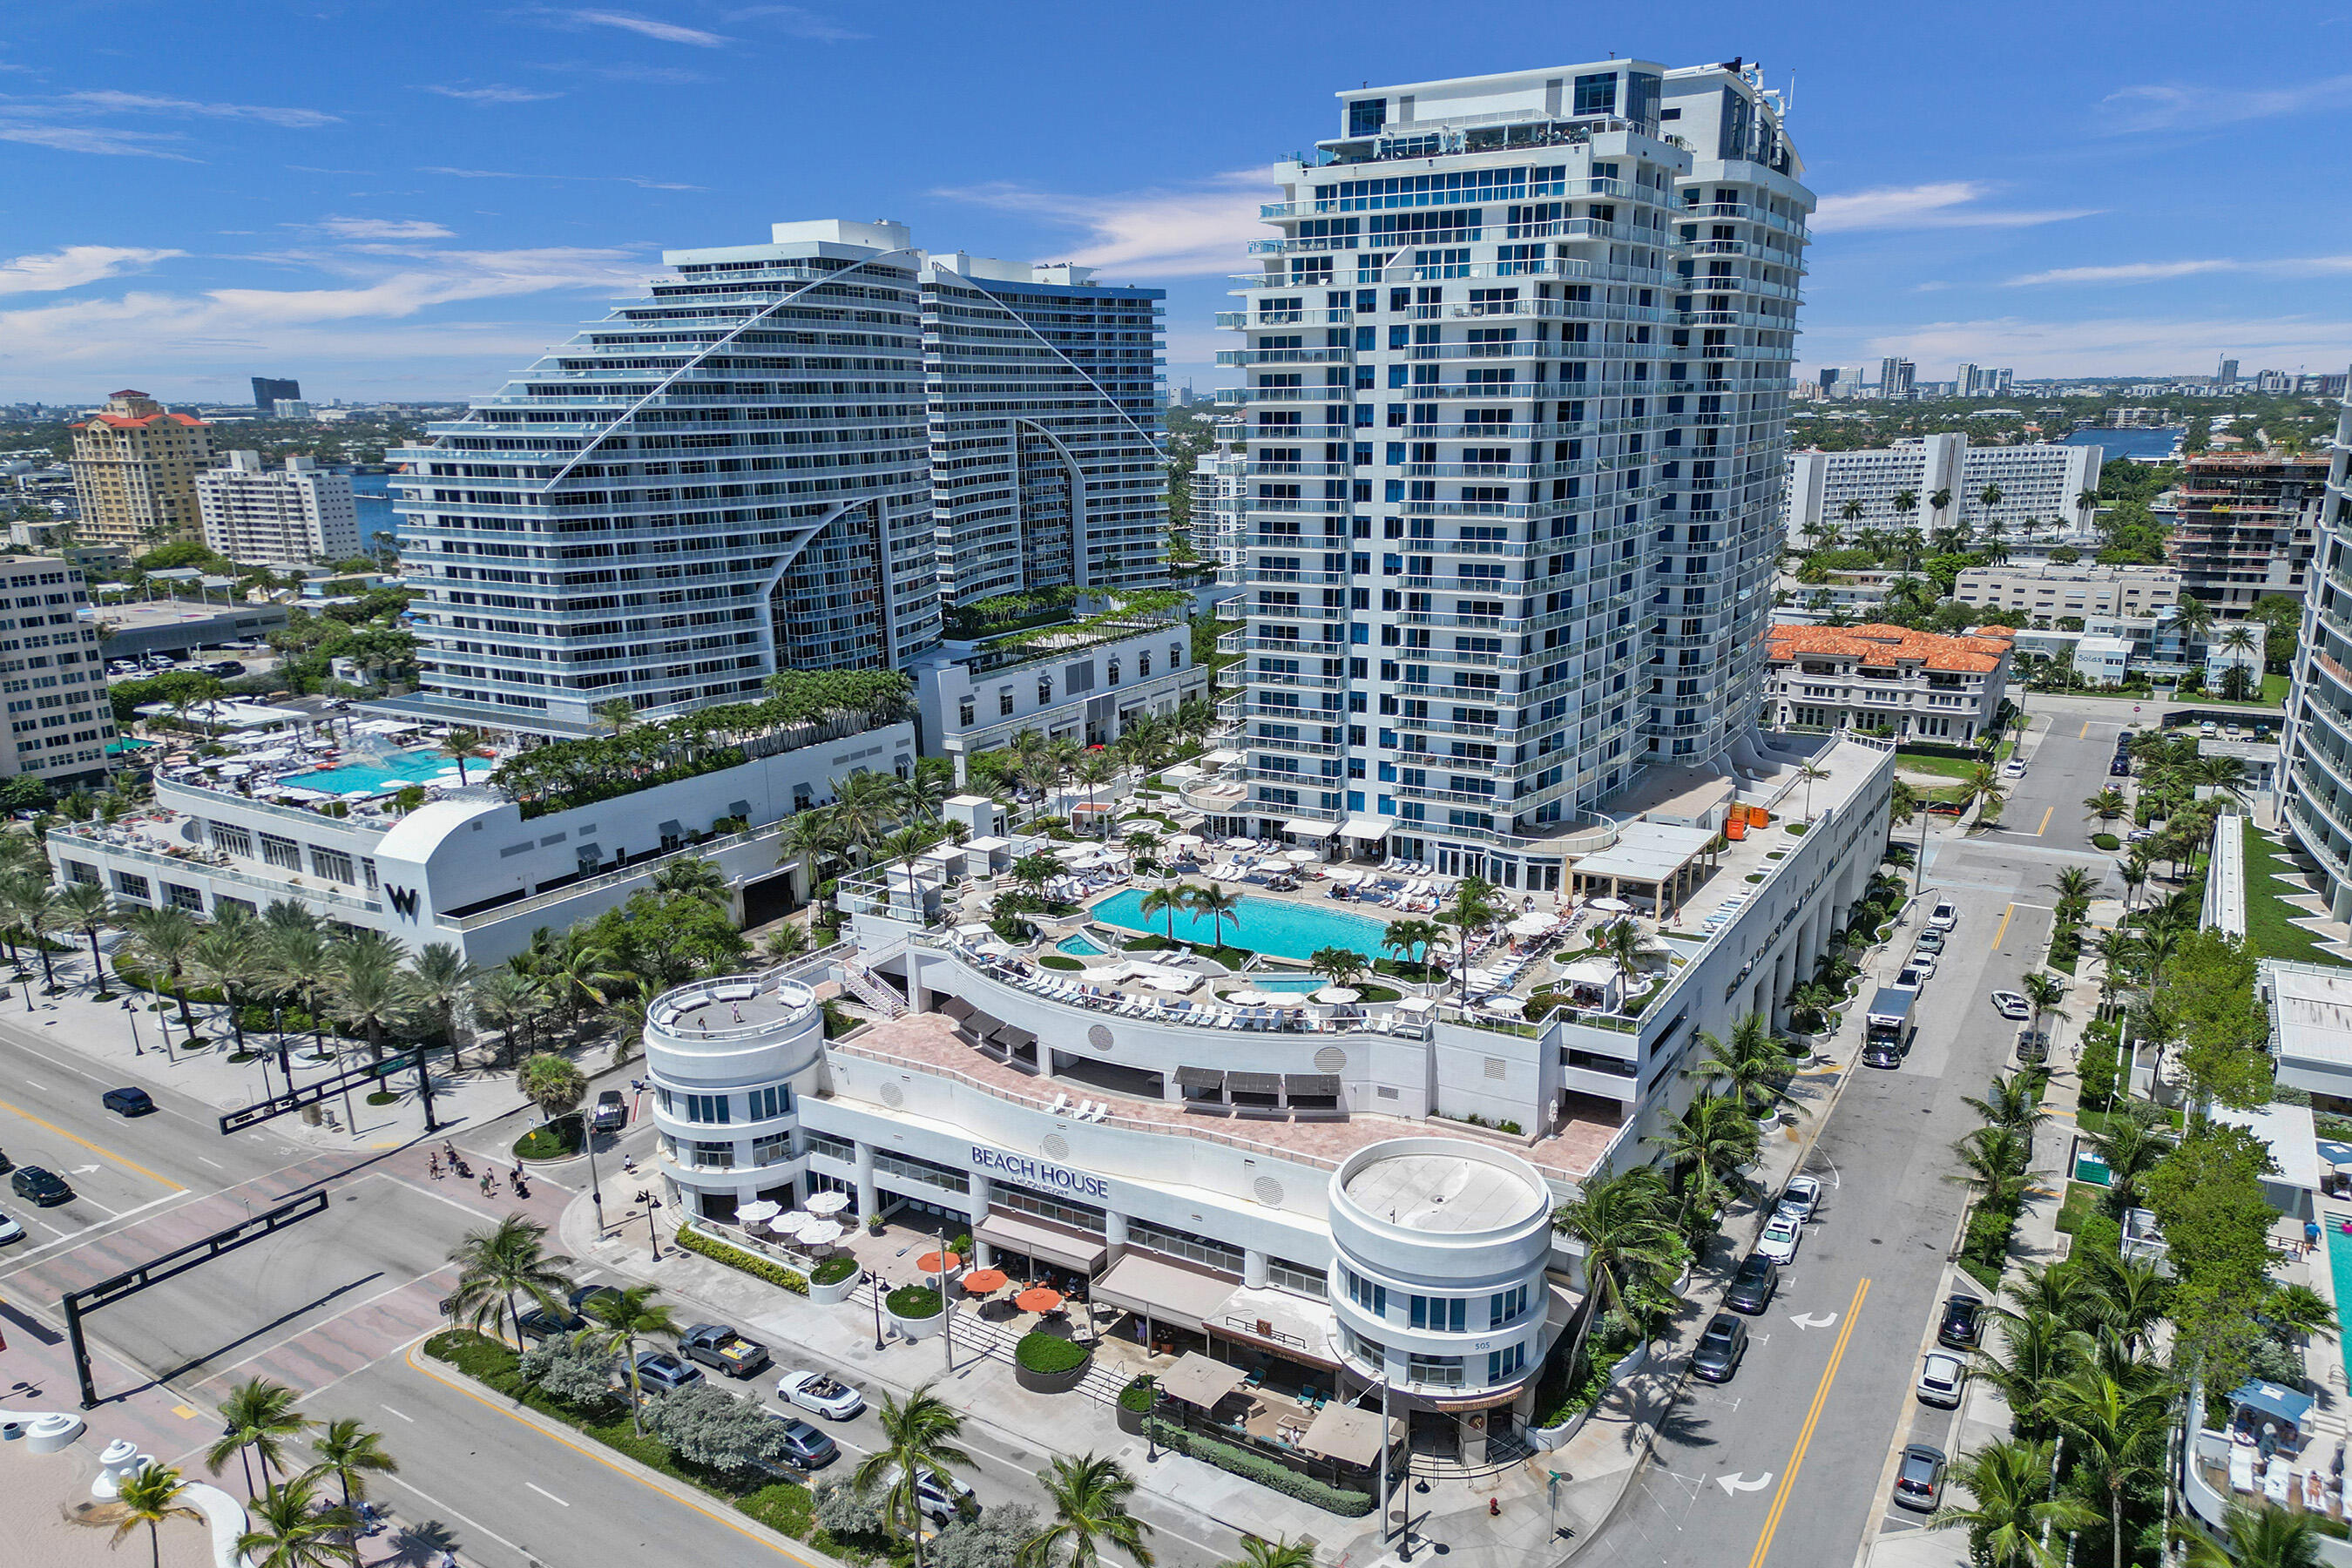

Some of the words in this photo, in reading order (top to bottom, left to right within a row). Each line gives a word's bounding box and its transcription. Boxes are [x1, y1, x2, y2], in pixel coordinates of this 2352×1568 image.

[383, 882, 416, 916] W
[971, 1146, 1035, 1178] BEACH
[1041, 1164, 1109, 1200] HOUSE
[1475, 1342, 1490, 1350] 505
[1472, 1401, 1492, 1409] SURF
[1498, 1394, 1518, 1404] SAND
